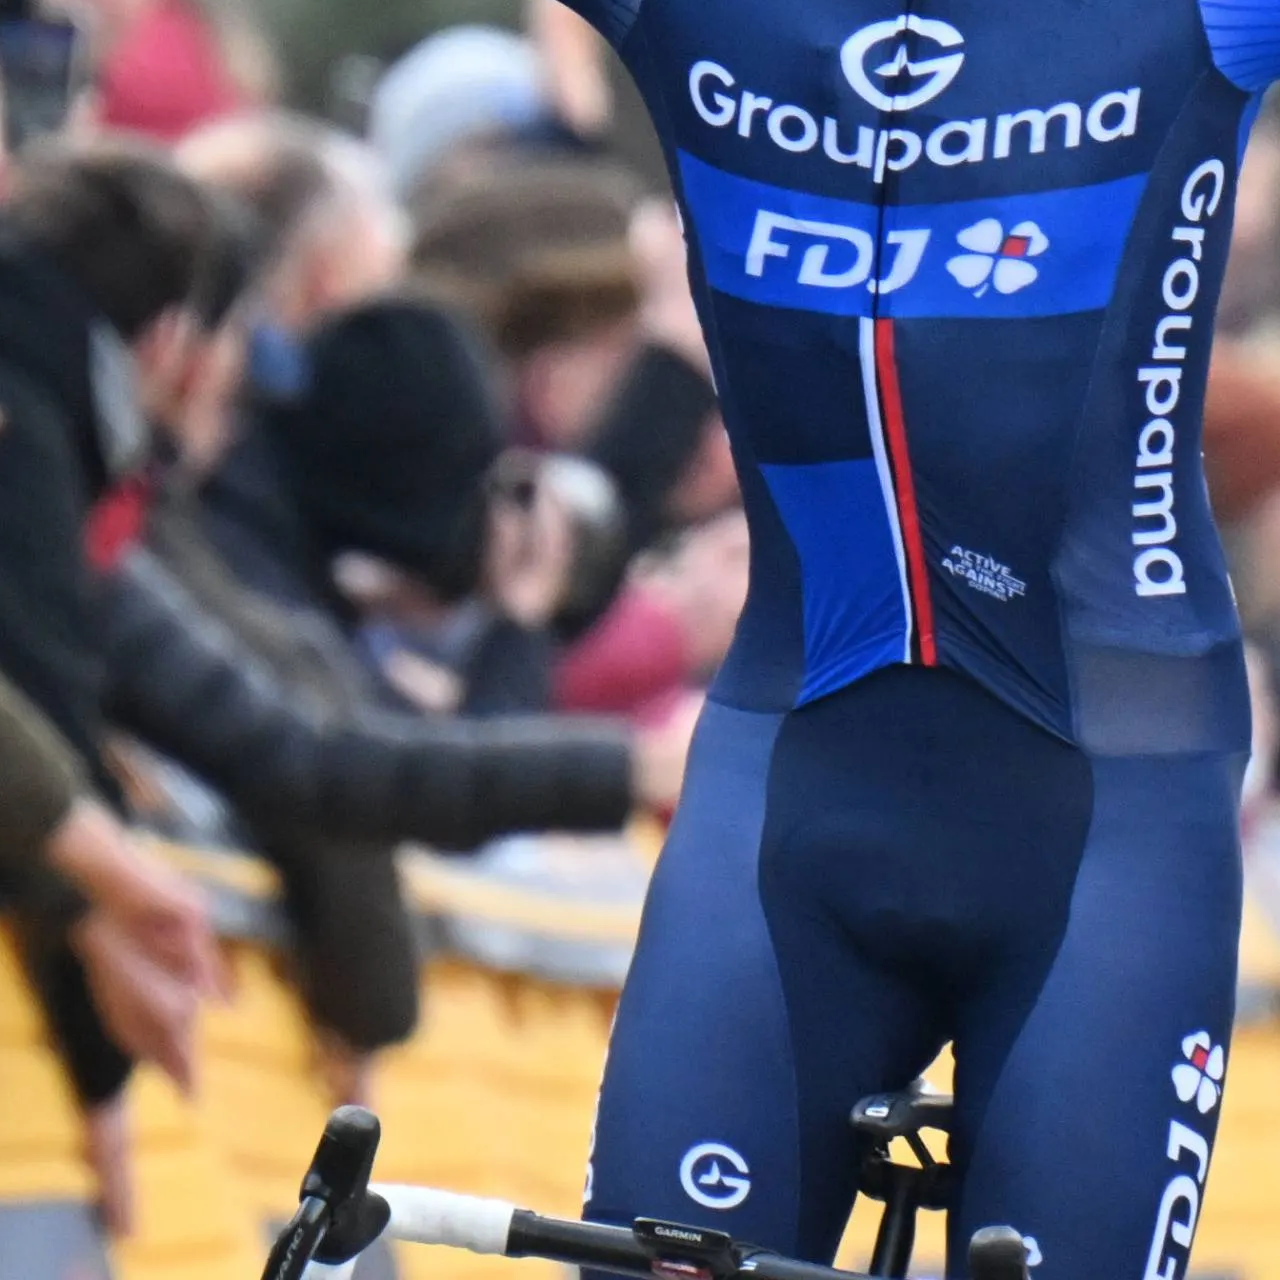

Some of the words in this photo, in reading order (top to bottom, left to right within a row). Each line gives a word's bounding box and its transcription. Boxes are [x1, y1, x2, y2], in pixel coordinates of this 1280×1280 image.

[688, 60, 1142, 184] Groupama
[745, 209, 931, 295] FDJ
[1132, 158, 1225, 598] Groupama
[941, 558, 1015, 598] AGAINST
[950, 545, 1012, 576] ACTIVE
[654, 1226, 702, 1242] GARMIN
